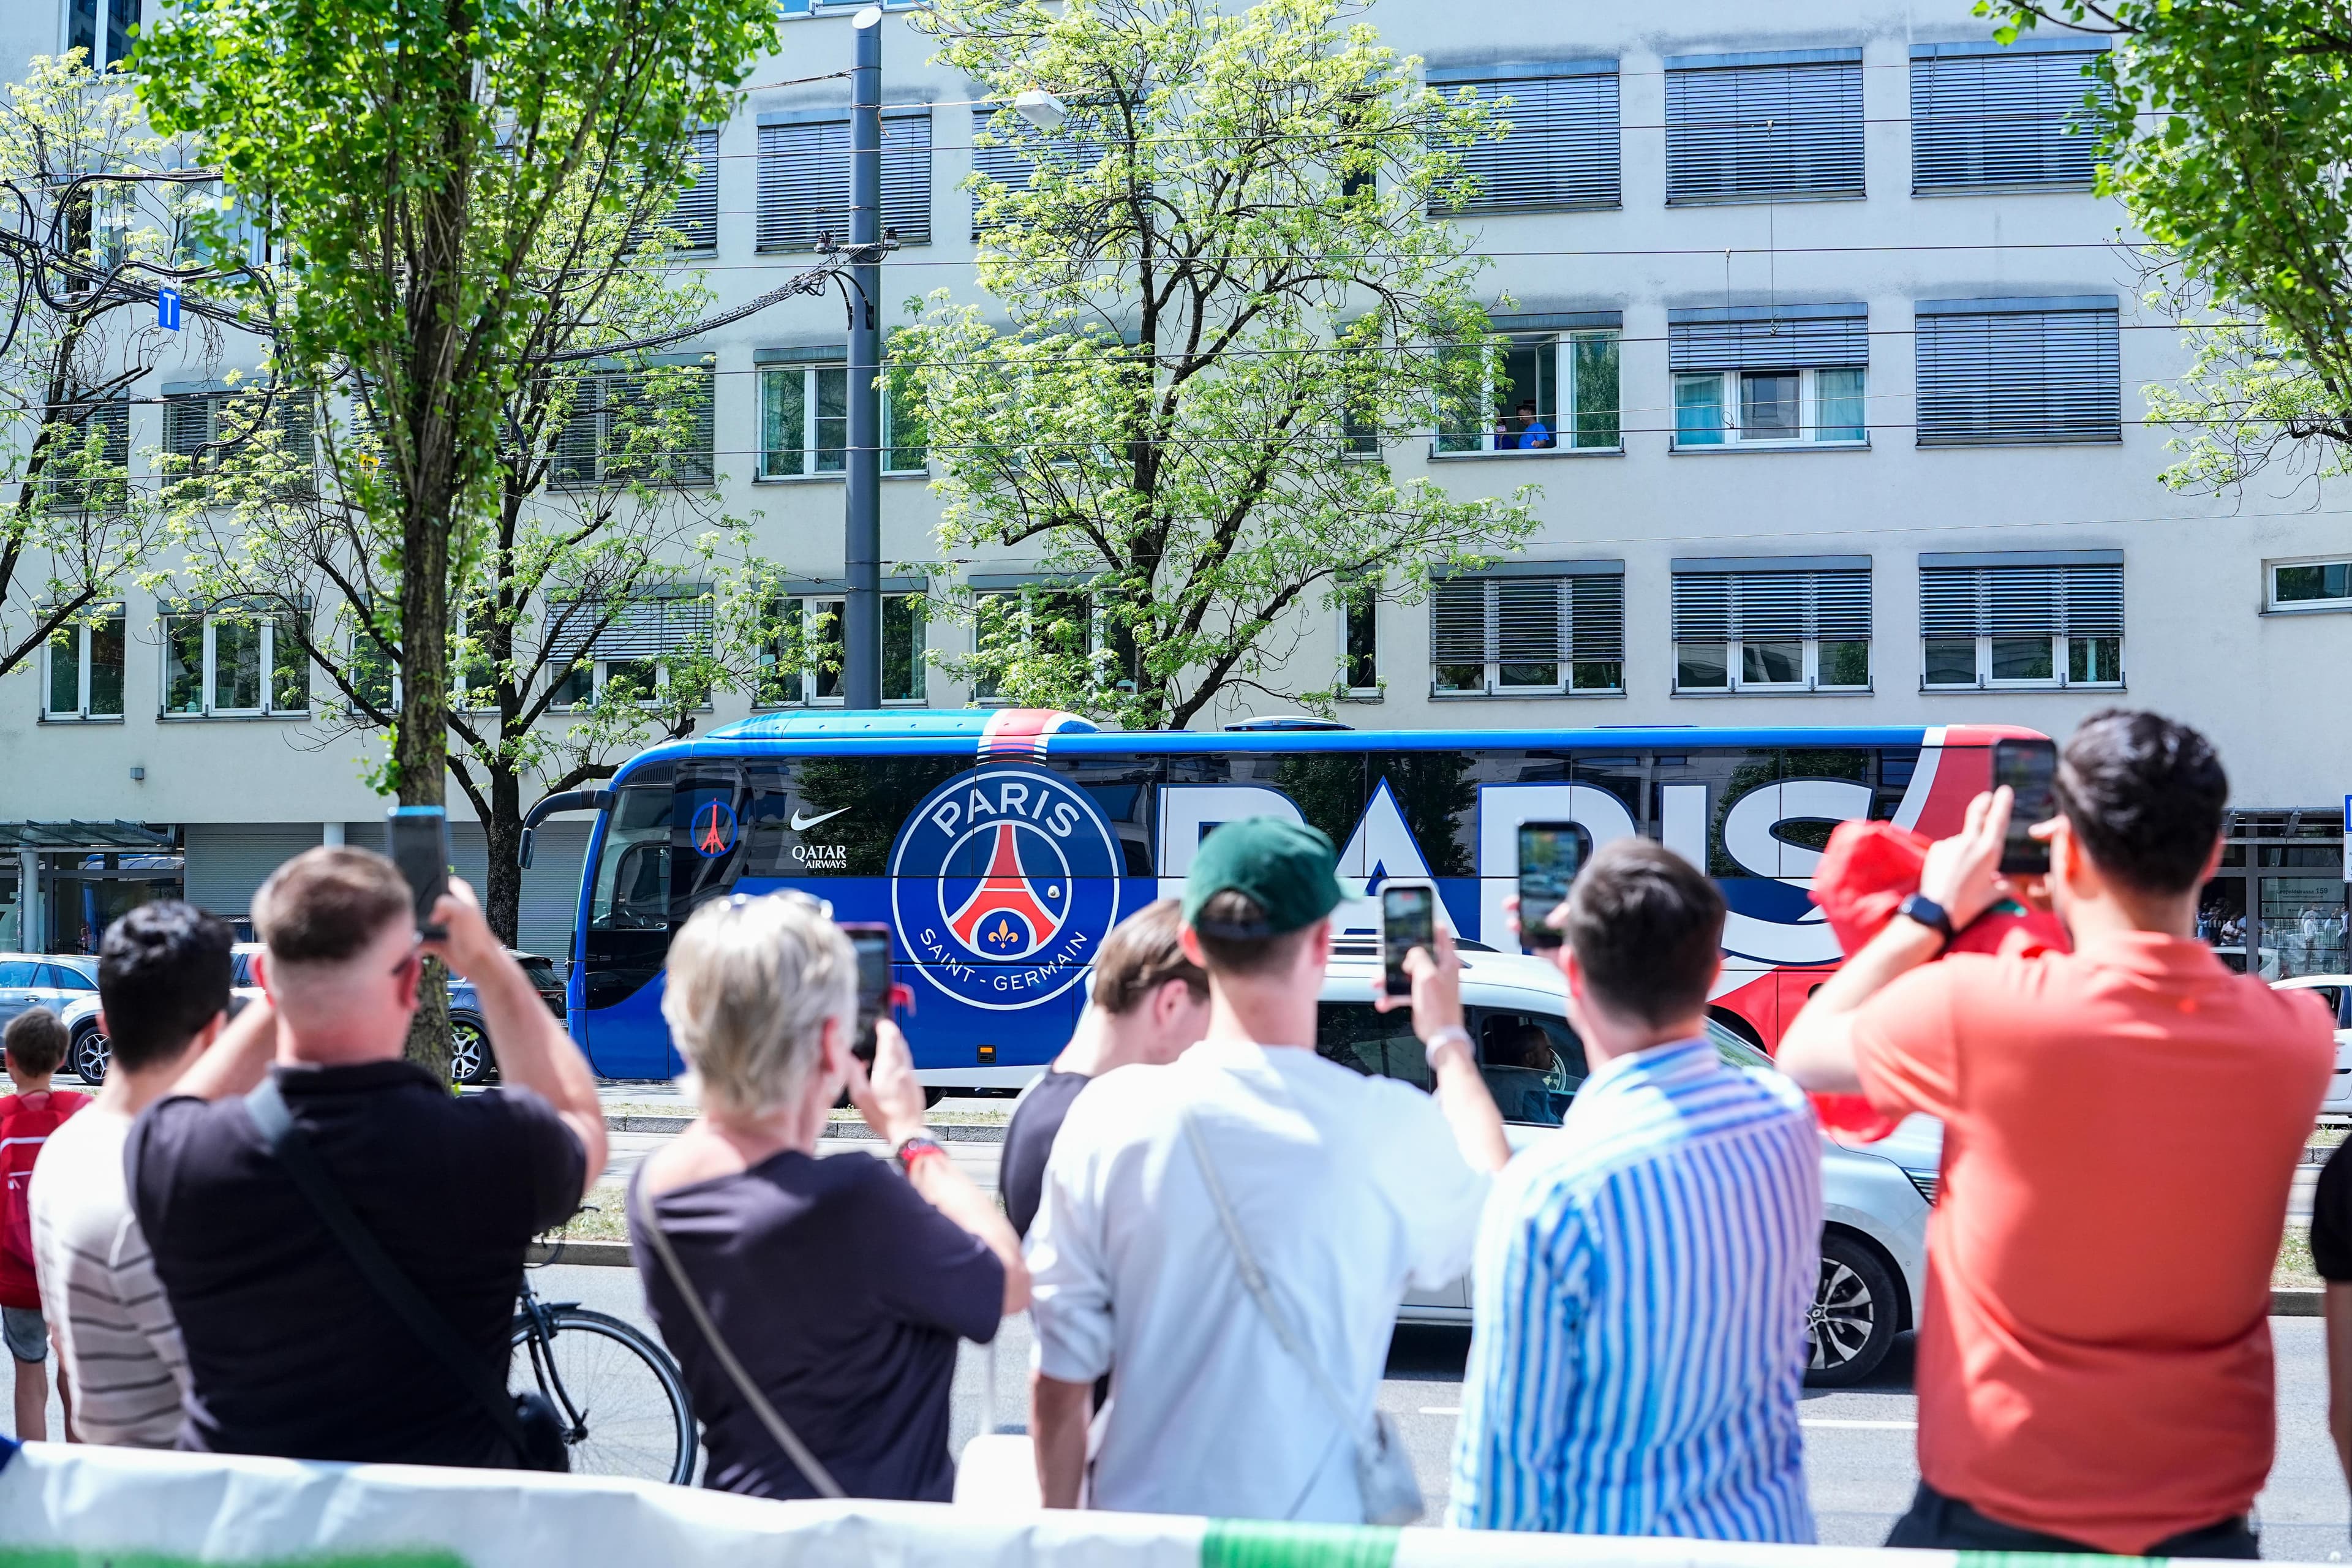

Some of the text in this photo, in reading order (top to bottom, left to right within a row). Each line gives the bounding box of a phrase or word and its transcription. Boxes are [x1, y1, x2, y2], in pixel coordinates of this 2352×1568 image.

[163, 292, 176, 325] T
[932, 783, 1080, 838] PARIS
[792, 845, 846, 862] QATAR
[805, 859, 846, 869] AIRWAYS
[920, 928, 975, 982] SAINT
[993, 931, 1087, 991] GERMAIN
